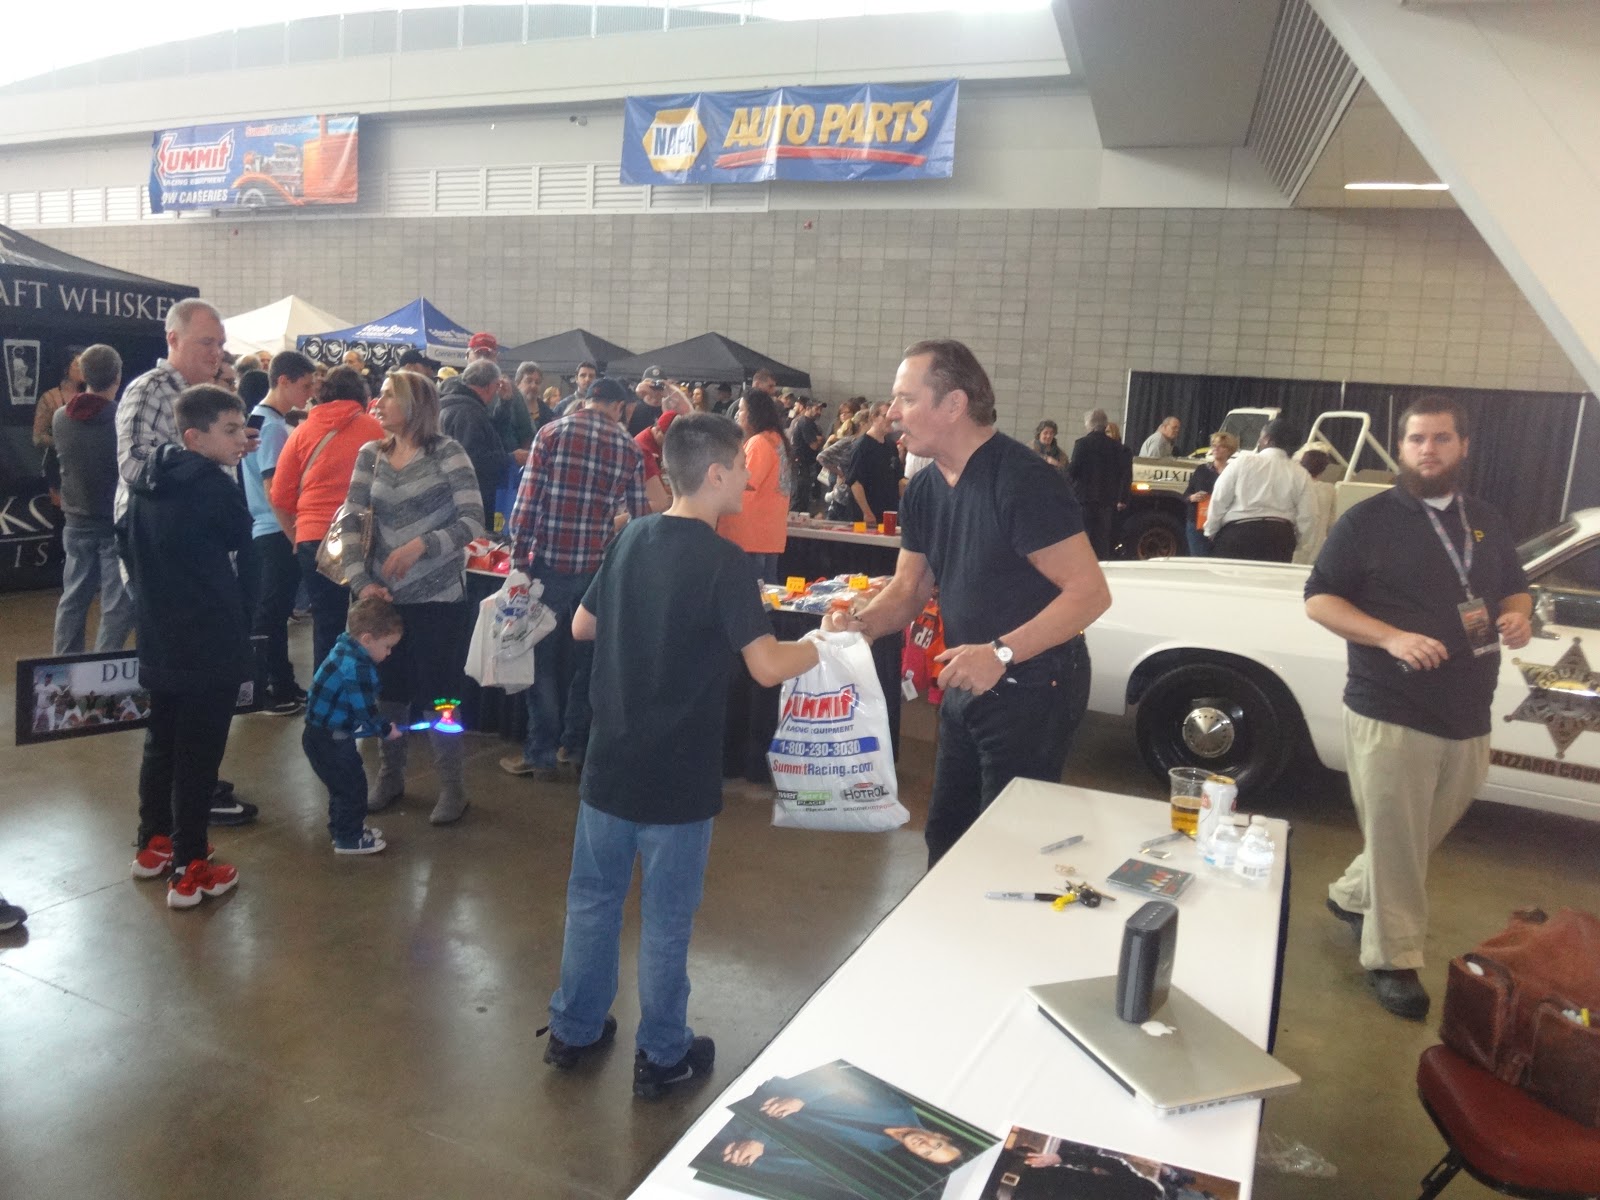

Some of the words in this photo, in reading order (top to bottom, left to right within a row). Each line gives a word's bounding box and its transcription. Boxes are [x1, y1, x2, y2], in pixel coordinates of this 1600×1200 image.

[653, 123, 696, 157] NAPA
[722, 103, 816, 149] AUTO
[819, 99, 933, 145] PARTS
[156, 131, 233, 178] SUMMIT
[780, 739, 860, 757] 1-800-230-3030
[772, 758, 874, 777] SummitRacing.com
